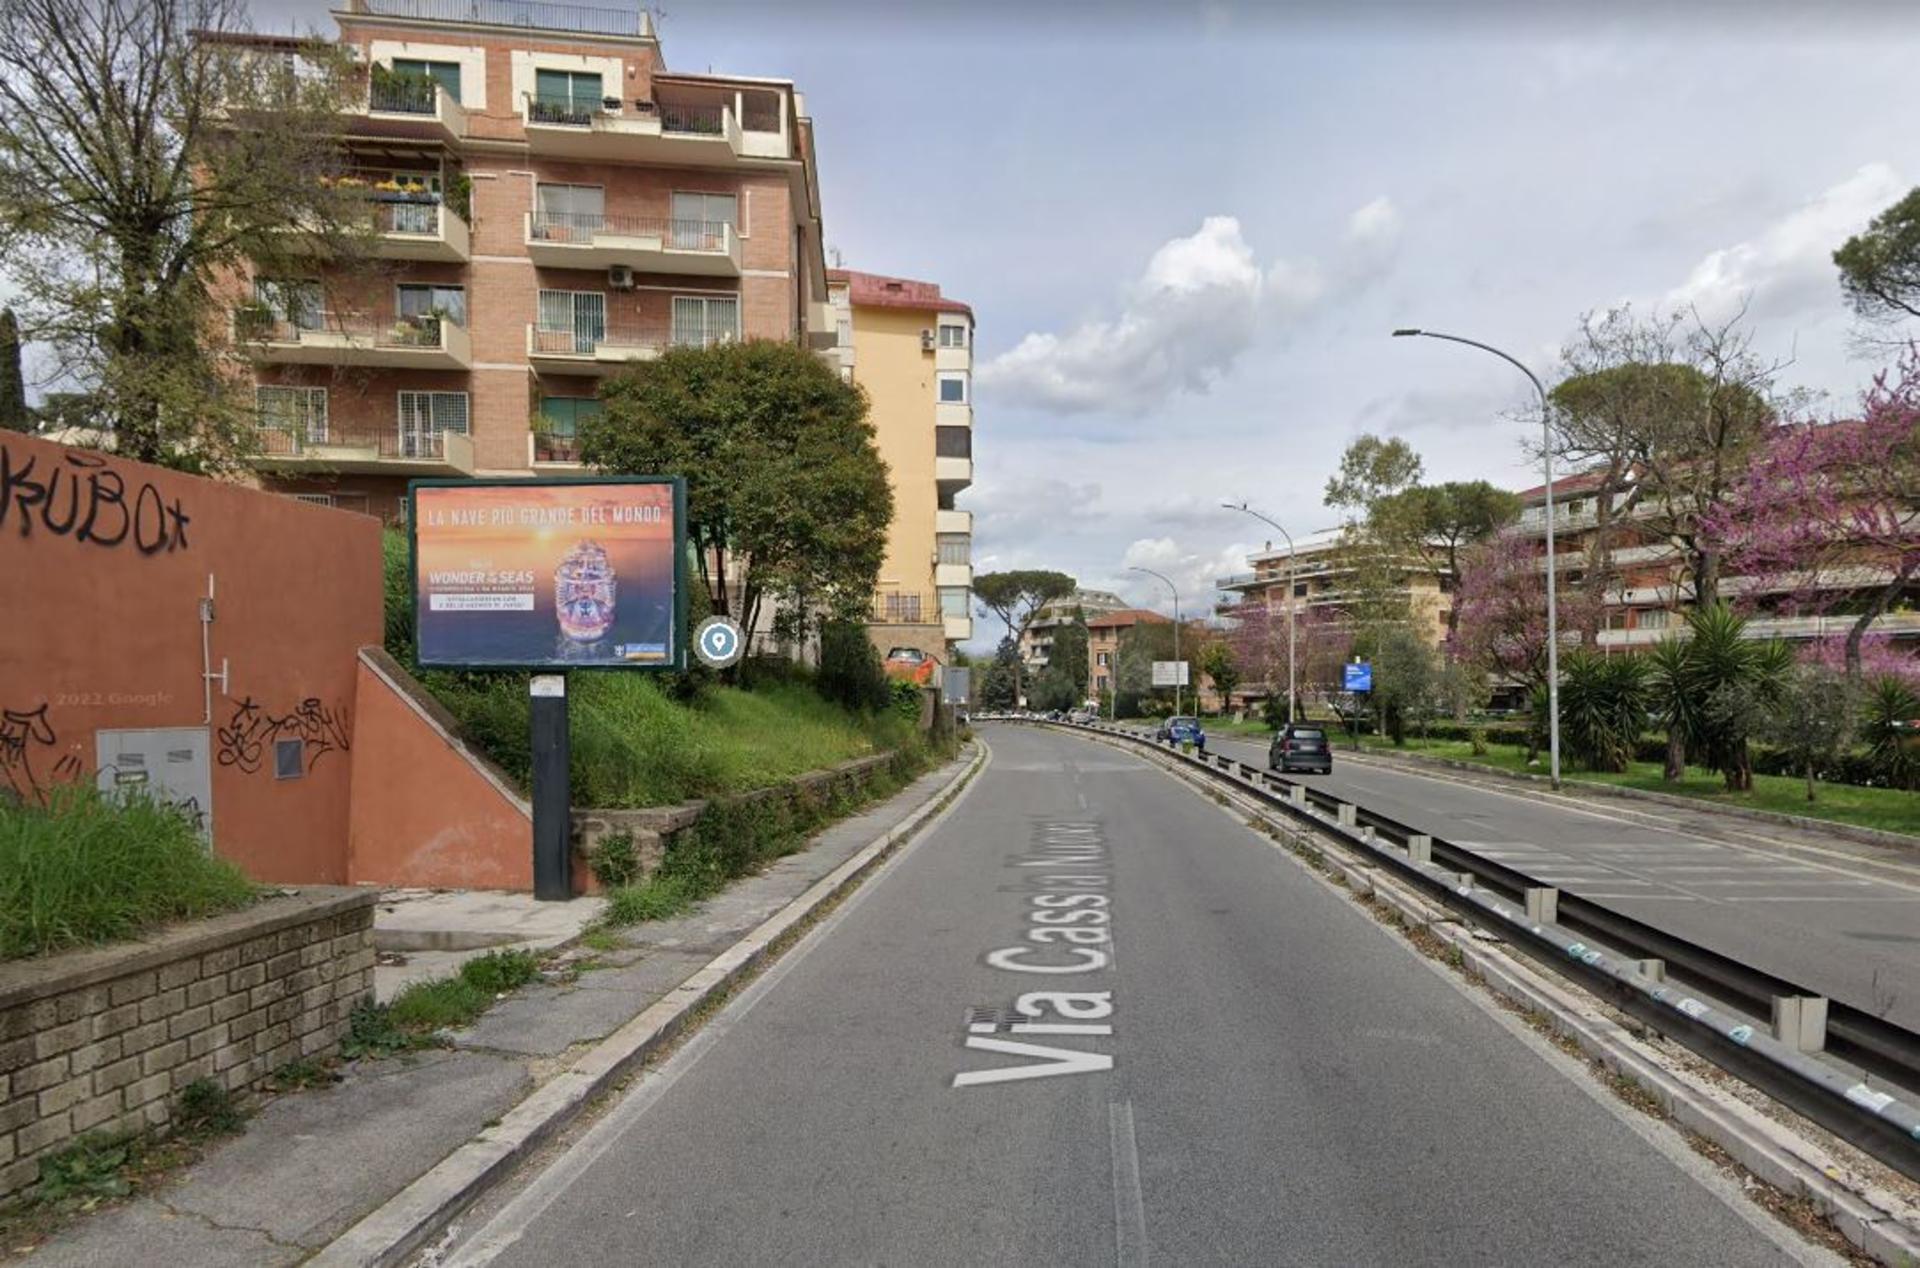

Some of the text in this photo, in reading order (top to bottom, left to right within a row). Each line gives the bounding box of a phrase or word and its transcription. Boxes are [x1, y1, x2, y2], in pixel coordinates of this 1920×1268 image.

[428, 509, 445, 526] LA
[451, 509, 486, 526] NAVE
[520, 506, 574, 526] GRANDE
[582, 507, 606, 525] DEL
[429, 571, 485, 585] WONDER
[499, 570, 534, 585] SEAS
